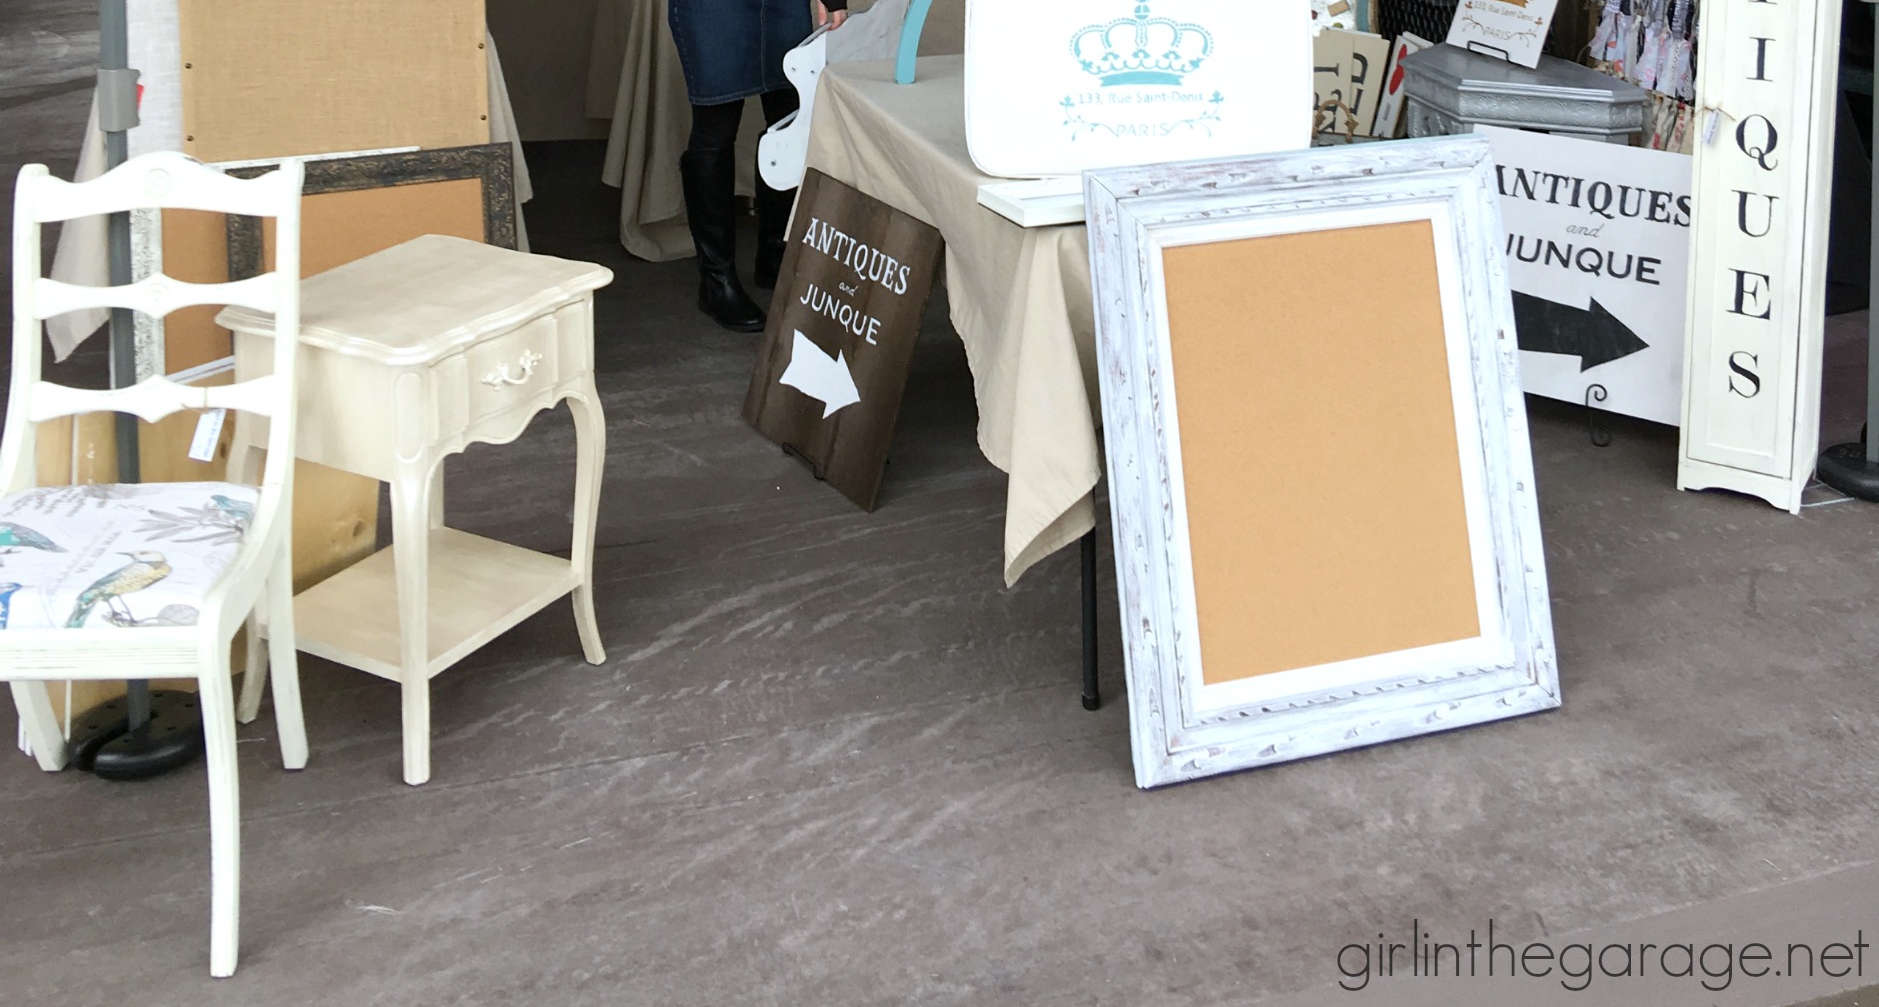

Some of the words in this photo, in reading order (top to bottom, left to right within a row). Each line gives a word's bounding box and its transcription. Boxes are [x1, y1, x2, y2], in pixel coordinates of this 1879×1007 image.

[1078, 93, 1104, 105] 133,
[1108, 92, 1132, 104] Rue
[1135, 90, 1204, 103] Saint-Denis
[1116, 123, 1170, 137] PARIS
[1566, 223, 1605, 238] and
[802, 217, 911, 295] ANTIQUES
[838, 280, 859, 297] and
[799, 283, 881, 345] JUNQUE
